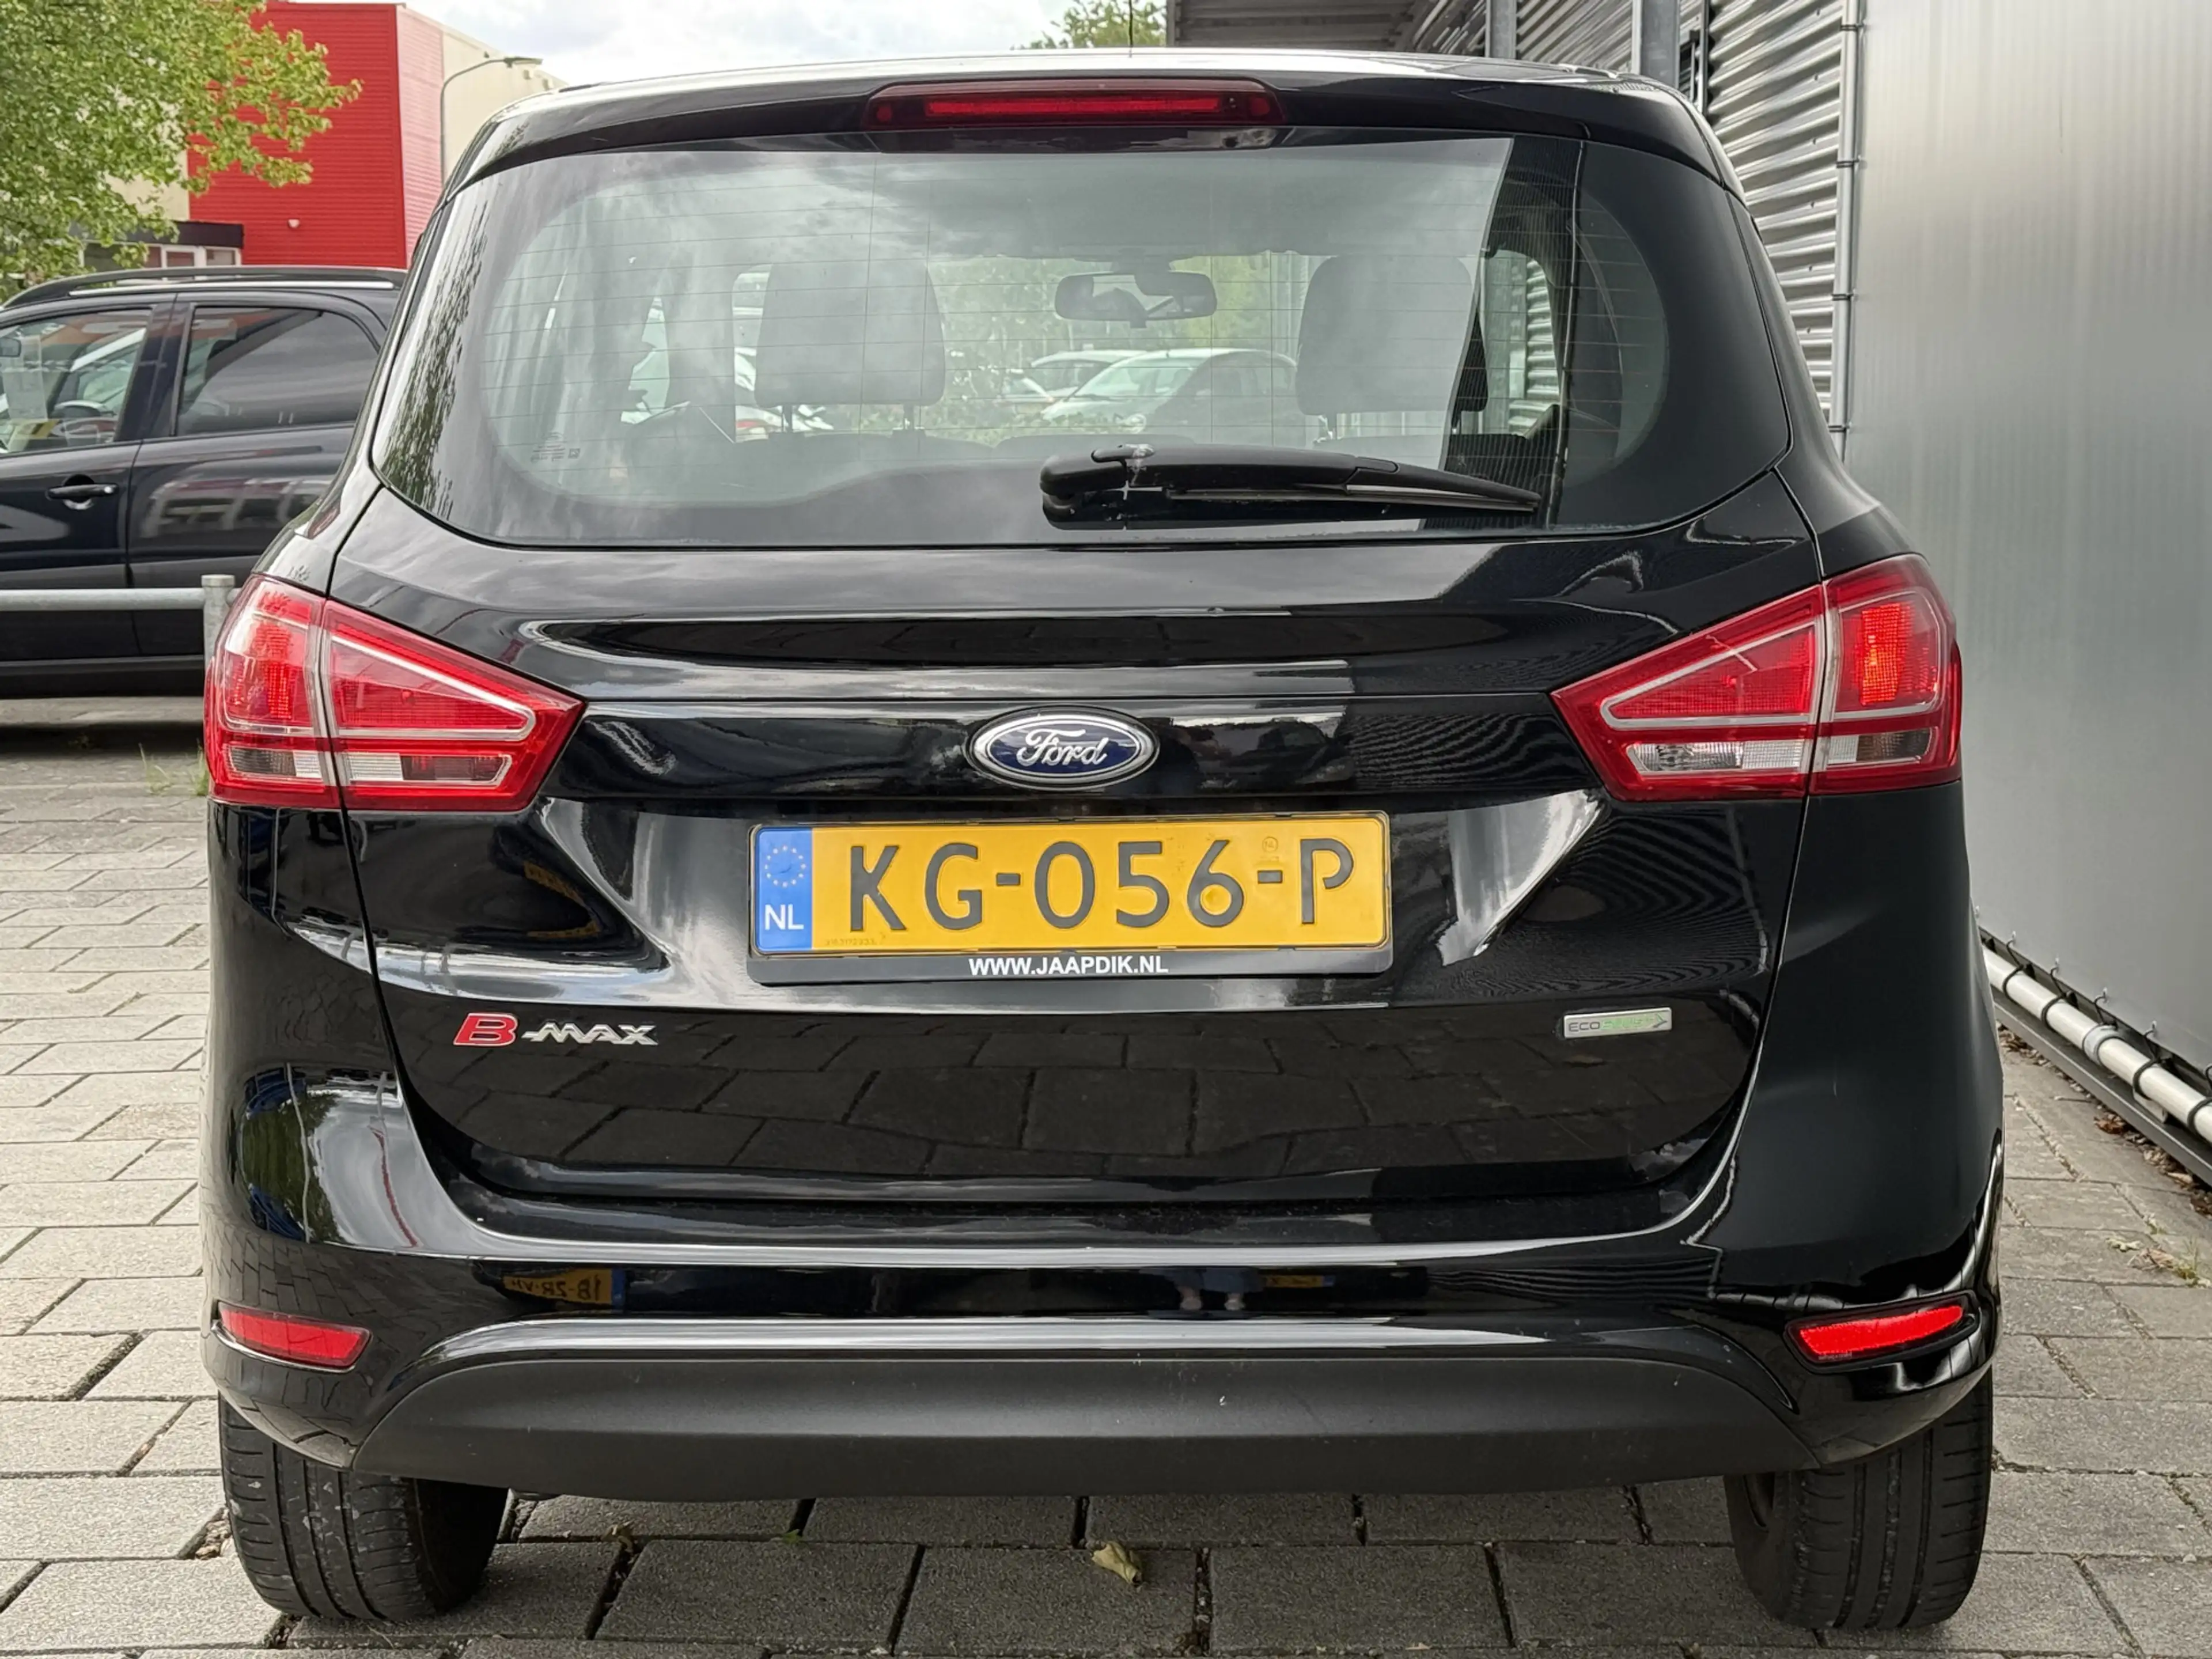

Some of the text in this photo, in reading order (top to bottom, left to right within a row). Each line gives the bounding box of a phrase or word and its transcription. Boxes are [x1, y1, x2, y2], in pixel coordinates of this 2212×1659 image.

[1016, 728, 1109, 766] Ford
[850, 837, 1355, 932] KG-056-P
[764, 904, 804, 931] NL
[968, 955, 1169, 975] WWW.JAAPDIK.NL
